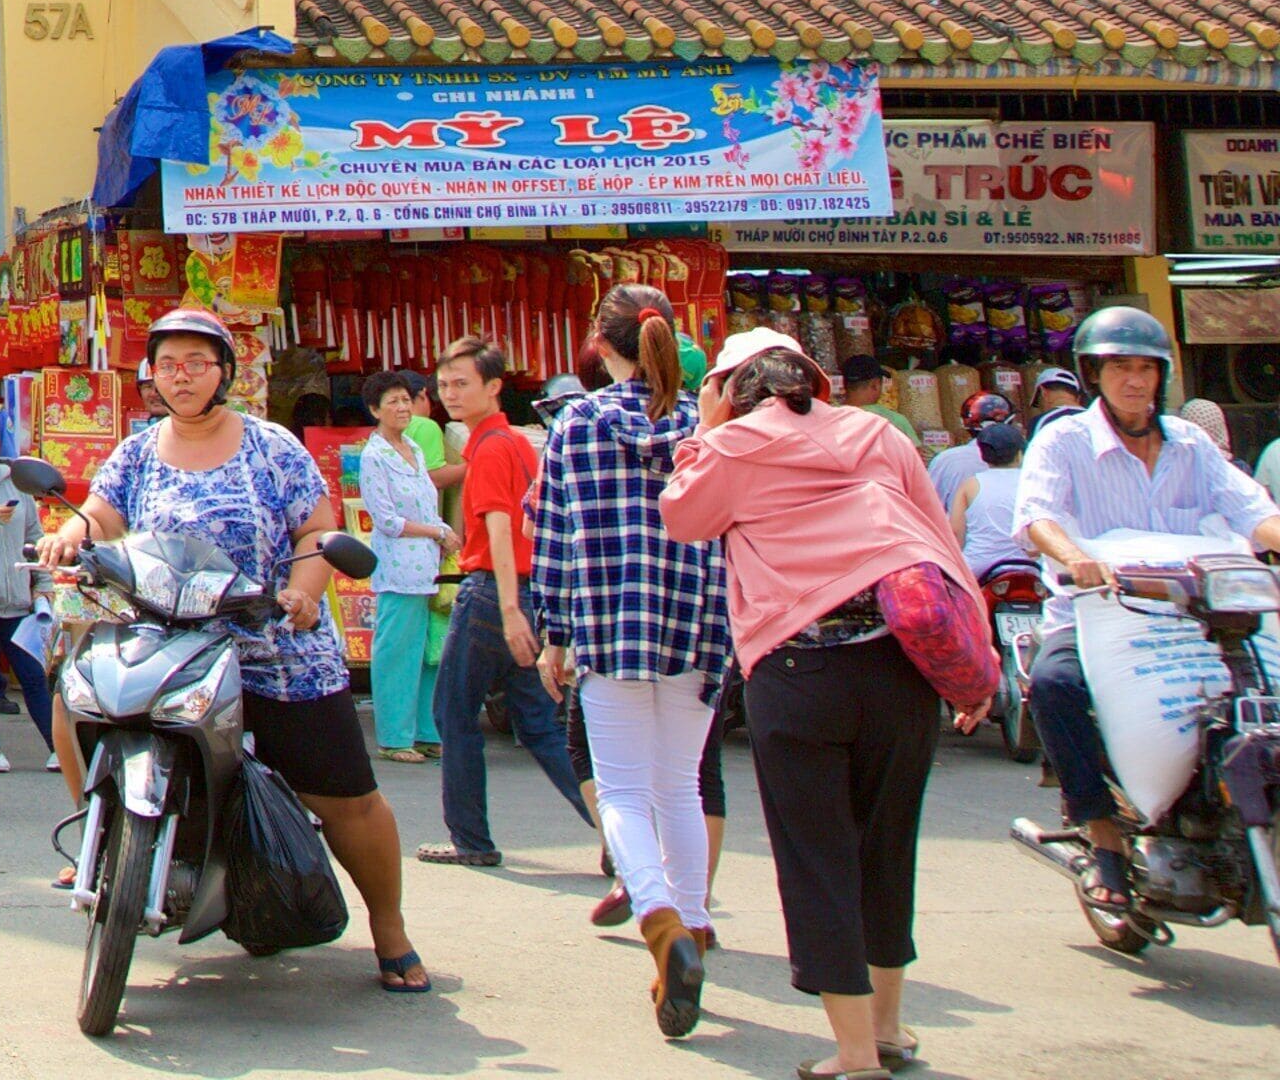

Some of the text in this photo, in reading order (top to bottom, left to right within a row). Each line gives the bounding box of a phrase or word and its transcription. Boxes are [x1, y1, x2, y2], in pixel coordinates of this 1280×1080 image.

[23, 2, 95, 41] 57A
[412, 71, 480, 85] TNHH
[432, 86, 576, 104] CHI NHÁNH
[351, 104, 696, 151] MỸ LỆ
[917, 123, 986, 149] PHẨM
[995, 120, 1045, 150] CHẾ
[1053, 118, 1111, 150] BIẾN
[1227, 138, 1278, 152] DOANH
[340, 154, 710, 175] CHUYÊN MUA BÁN CÁC LOẠI LỊCH 2015
[184, 184, 226, 205] NHẬN
[231, 179, 275, 200] THIẾT
[281, 177, 301, 199] KẾ
[307, 183, 340, 201] LỊCH
[345, 179, 376, 200] ĐỘC
[381, 175, 431, 198] QUYỀN
[446, 179, 488, 199] NHẬN
[492, 181, 506, 195] IN
[512, 177, 573, 196] OFFSET,
[577, 170, 597, 193] BẾ
[603, 175, 633, 195] HỘP
[648, 172, 669, 191] ÉP
[674, 174, 702, 189] KIM
[705, 171, 746, 189] TRÊN
[751, 173, 779, 190] MỌI
[783, 168, 822, 187] CHẤT
[924, 156, 1093, 201] TRÚC
[1199, 170, 1252, 209] TIỆM
[212, 211, 237, 226] 57B
[242, 207, 276, 224] THÁP
[433, 203, 472, 220] CHÍNH
[476, 205, 502, 221] CHỢ
[507, 203, 537, 219] BÌNH
[542, 201, 568, 218] TÂY
[611, 201, 672, 216] 39506811
[685, 199, 748, 214] 39522179
[787, 196, 871, 211] 0917.182425
[945, 205, 1032, 227] SỈ & LẺ
[1205, 213, 1244, 227] MUA
[736, 227, 948, 245] THÁP MƯỜI CHỢ BÌNH TÂY P.2.Q.6
